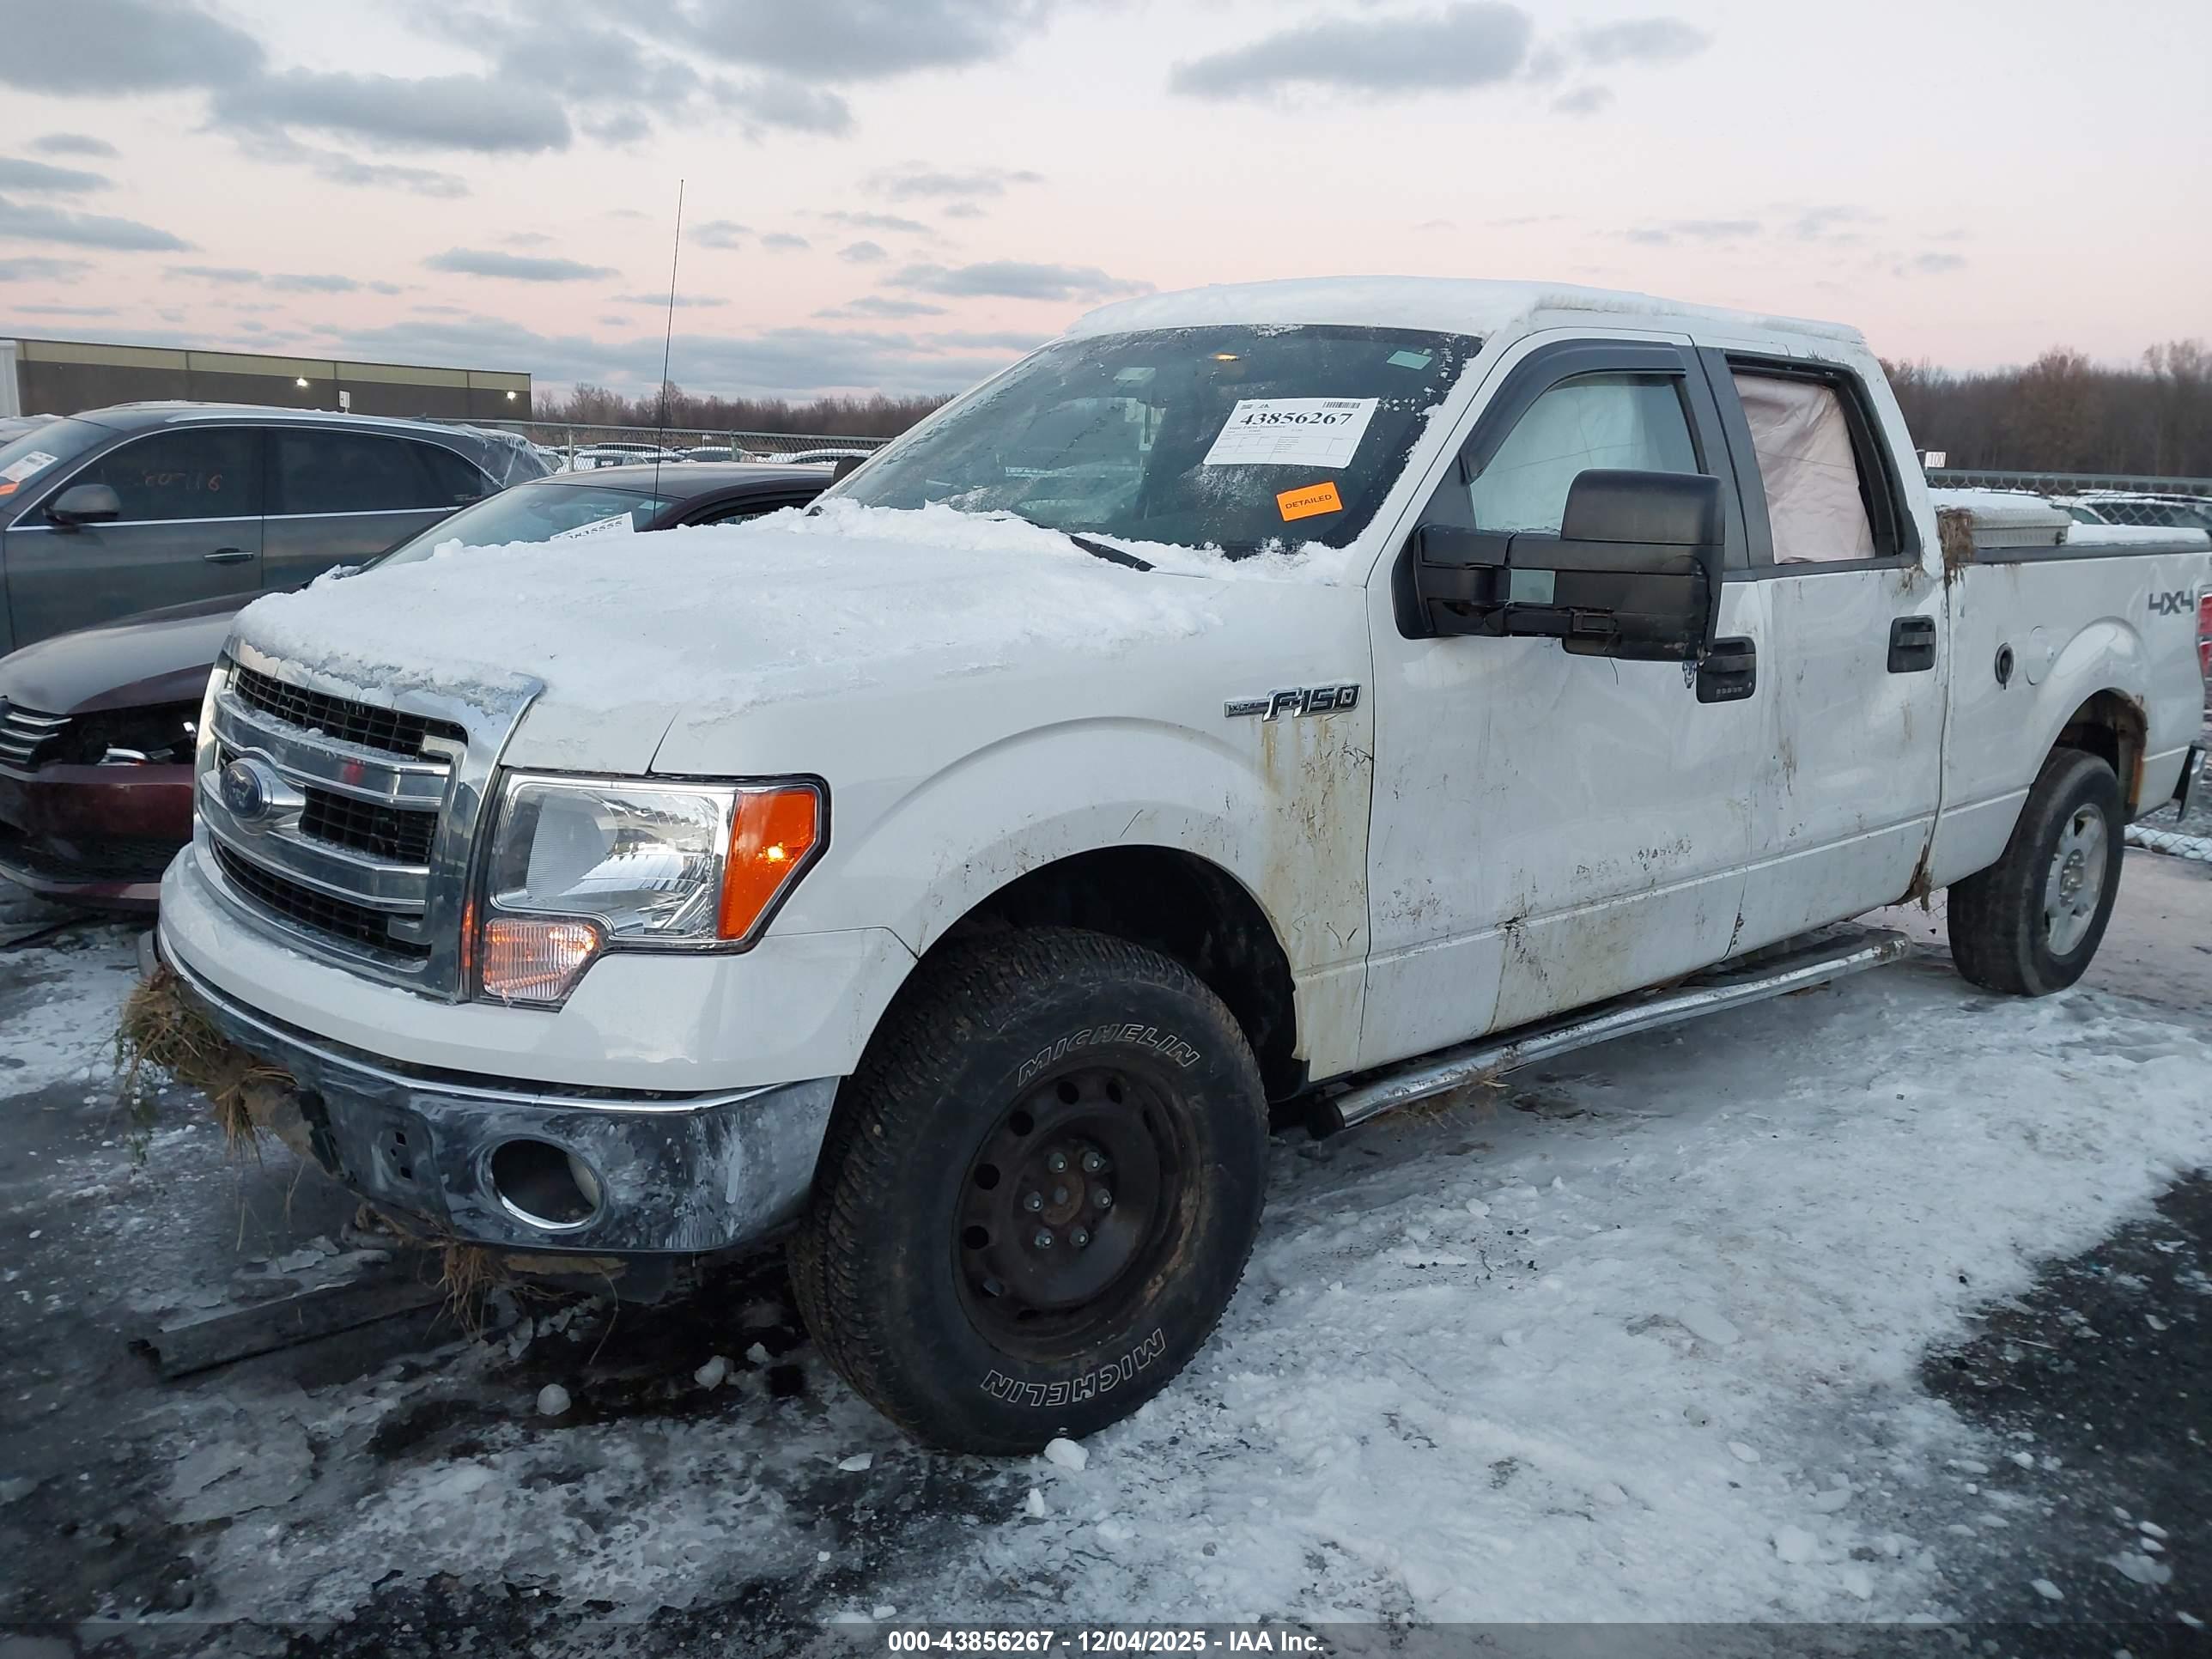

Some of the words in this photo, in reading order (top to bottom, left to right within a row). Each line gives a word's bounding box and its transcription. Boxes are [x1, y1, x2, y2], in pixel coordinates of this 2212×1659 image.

[1240, 412, 1354, 426] 43856267
[1285, 494, 1333, 509] DETAILED
[1017, 1024, 1201, 1088] MICHELIN
[980, 1327, 1166, 1407] MICHELIN
